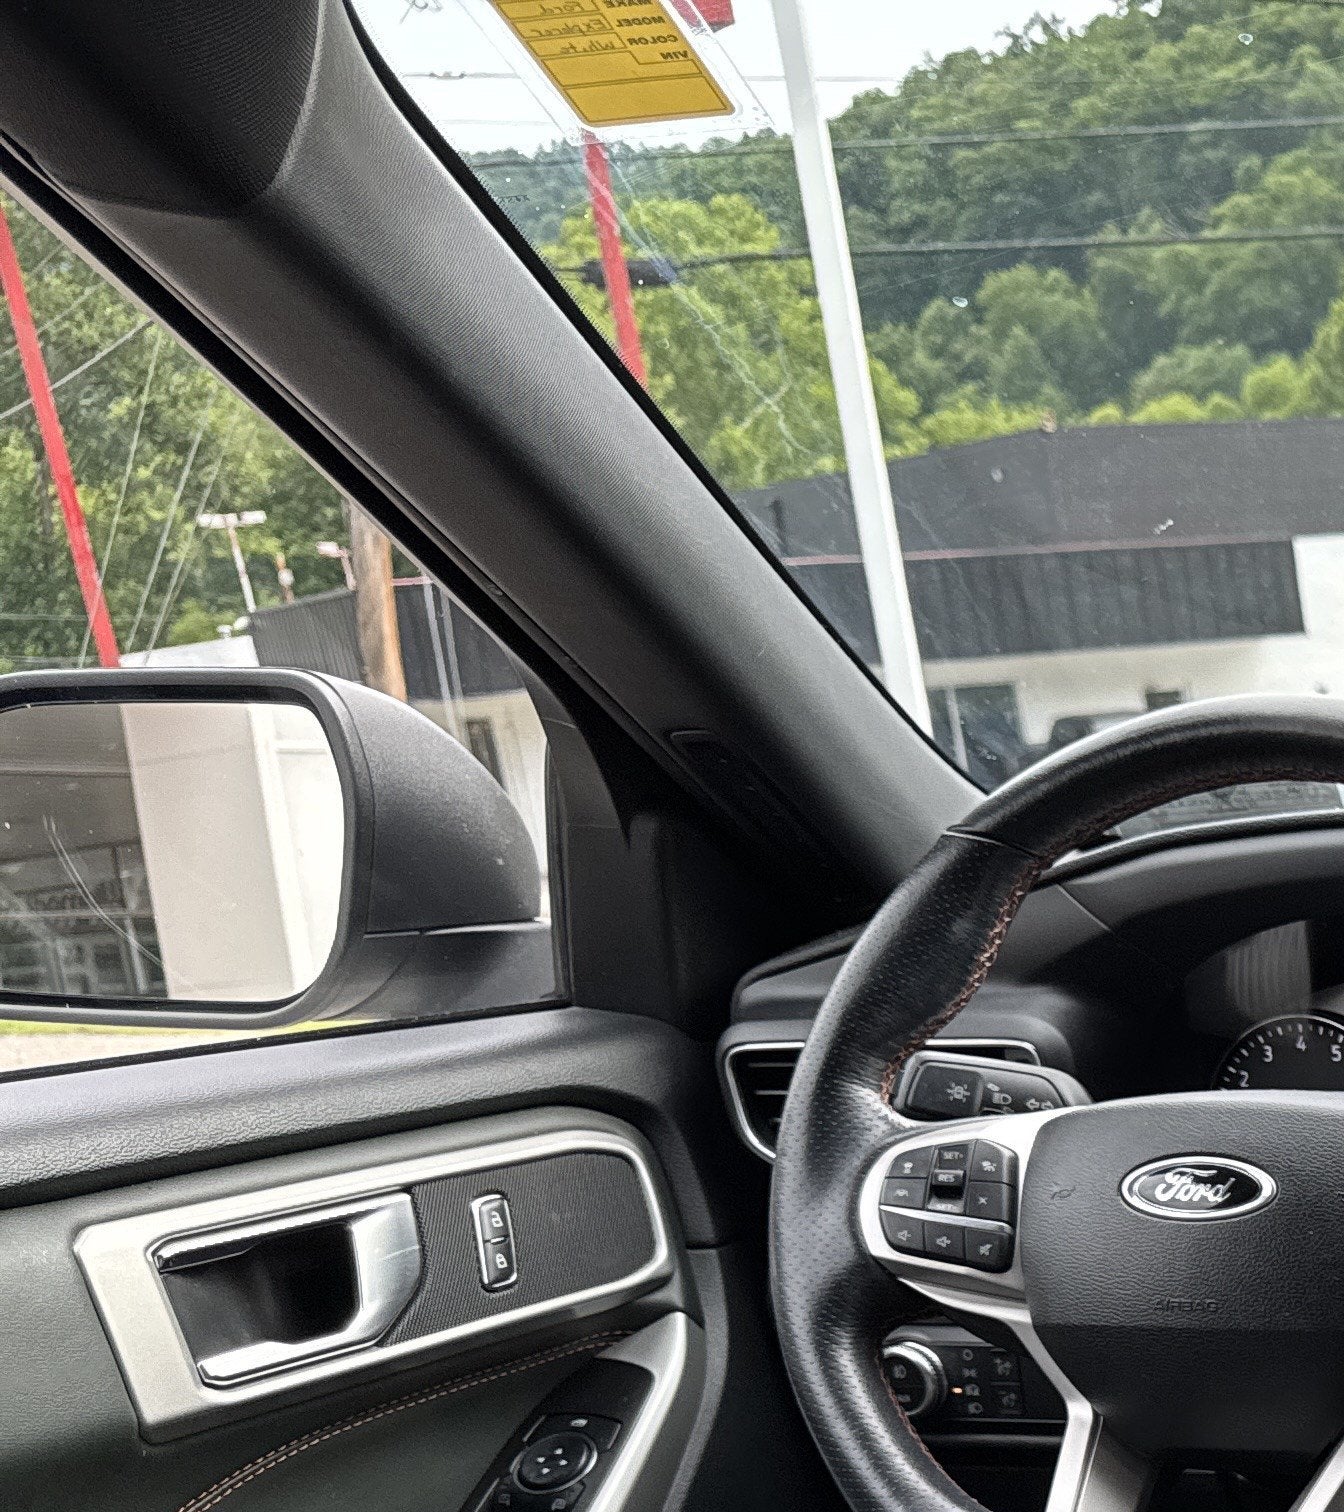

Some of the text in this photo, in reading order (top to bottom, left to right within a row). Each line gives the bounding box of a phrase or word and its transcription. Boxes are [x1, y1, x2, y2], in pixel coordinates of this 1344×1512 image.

[1296, 1035, 1307, 1052] 4
[1263, 1045, 1273, 1062] 3
[1330, 1044, 1342, 1062] 5
[1239, 1070, 1249, 1088] 2
[1154, 1168, 1236, 1202] Ford
[1155, 1300, 1219, 1313] AIRBAG
